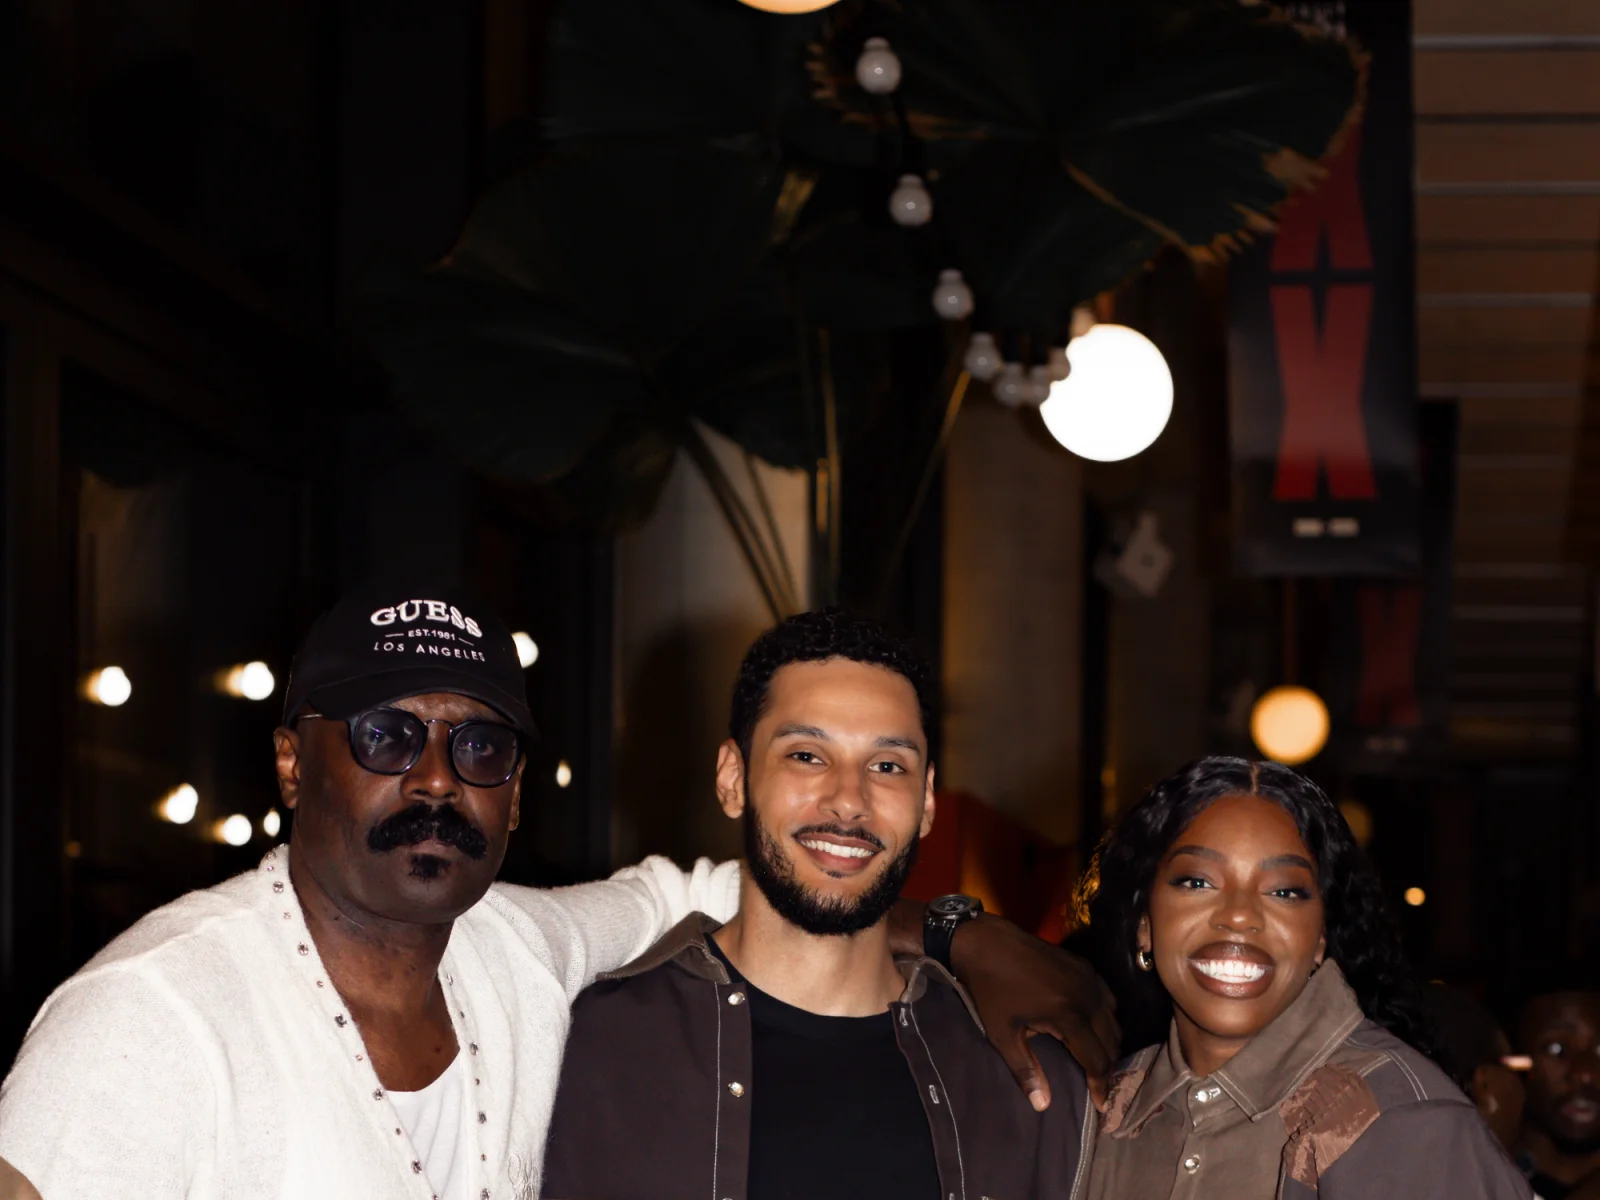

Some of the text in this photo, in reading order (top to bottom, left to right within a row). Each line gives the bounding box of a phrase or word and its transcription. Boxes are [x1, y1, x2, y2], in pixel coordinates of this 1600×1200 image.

[369, 599, 483, 638] GUESS
[373, 641, 486, 662] LOS ANGELES
